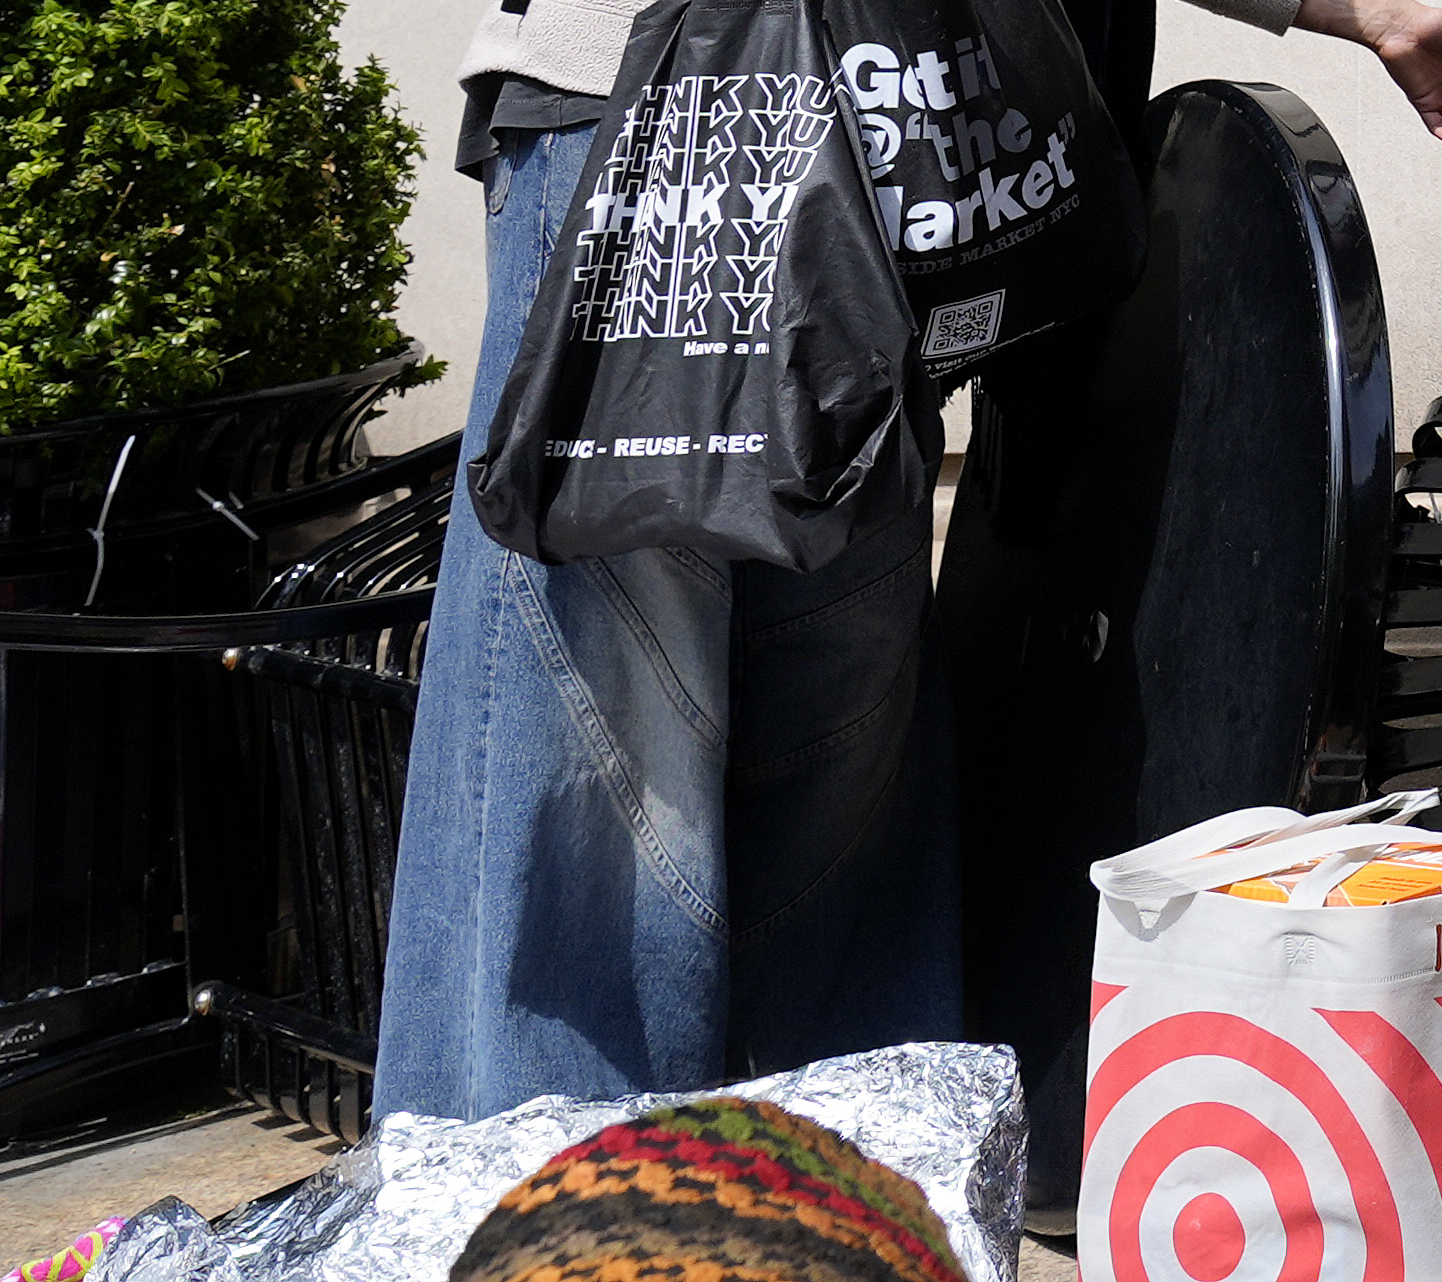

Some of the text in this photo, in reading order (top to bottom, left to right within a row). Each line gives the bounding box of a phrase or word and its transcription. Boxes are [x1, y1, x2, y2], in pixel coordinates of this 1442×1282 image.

[959, 217, 1047, 266] MARKET
[1049, 193, 1081, 225] NYC
[682, 340, 729, 356] Have
[733, 342, 750, 355] a
[613, 436, 691, 457] REUSE
